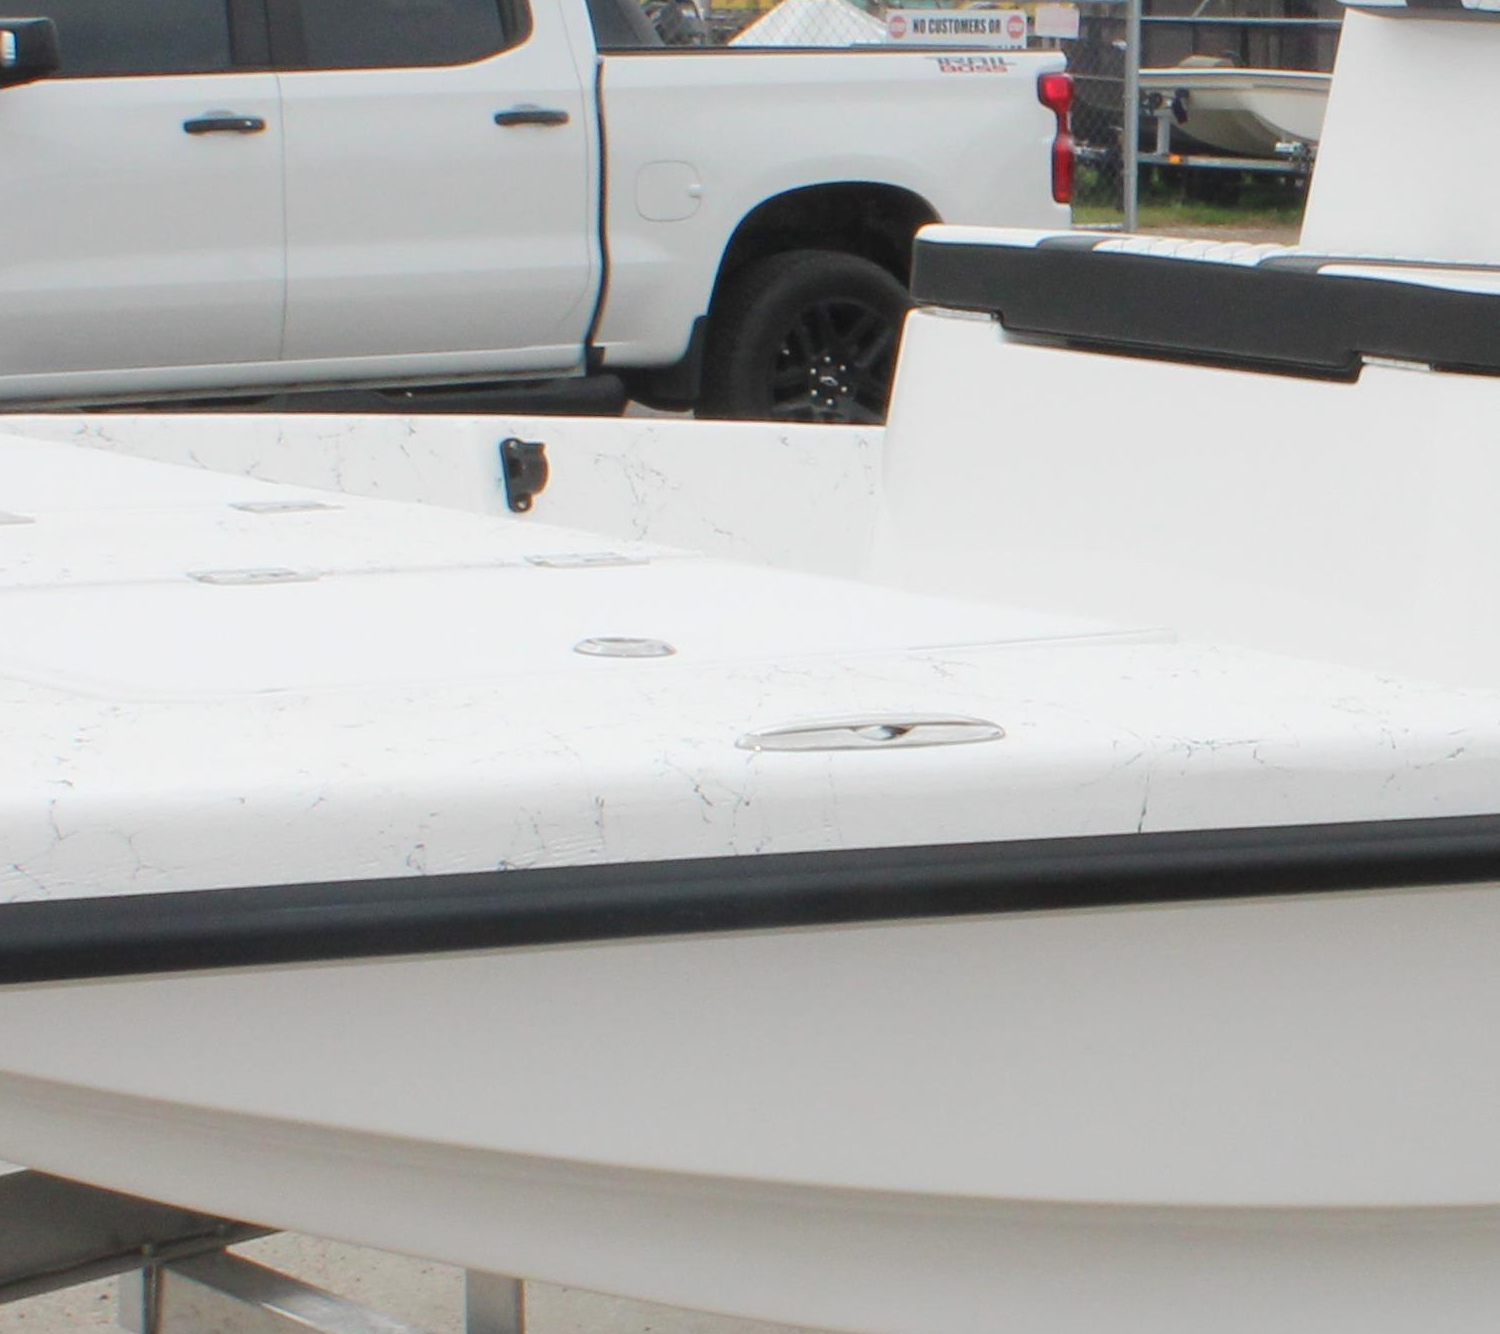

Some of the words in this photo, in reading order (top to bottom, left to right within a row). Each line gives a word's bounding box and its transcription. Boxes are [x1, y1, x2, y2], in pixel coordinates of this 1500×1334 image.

[912, 18, 926, 34] NO
[928, 18, 987, 34] CUSTOMERS
[988, 18, 1002, 34] OR
